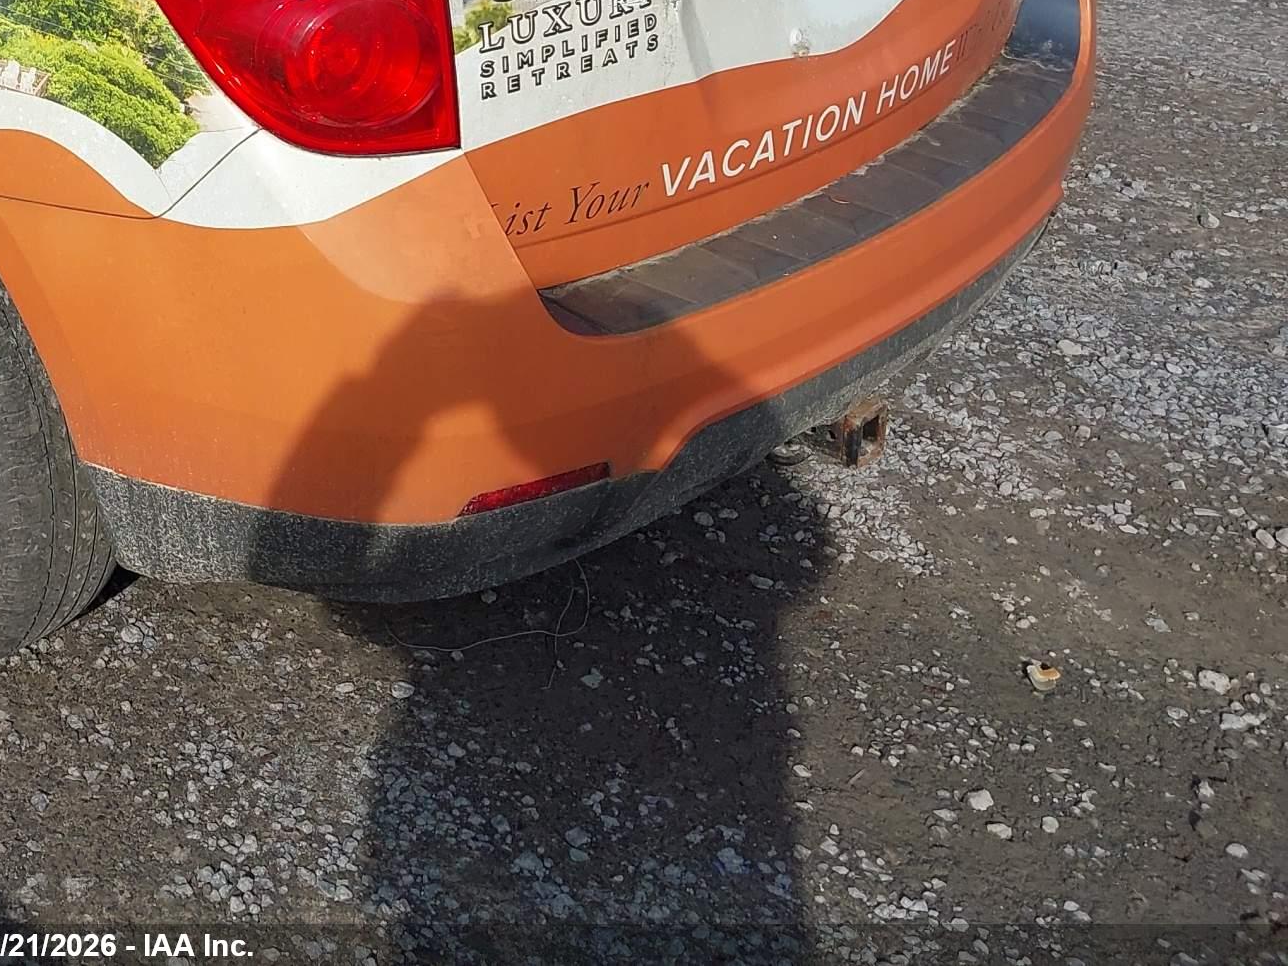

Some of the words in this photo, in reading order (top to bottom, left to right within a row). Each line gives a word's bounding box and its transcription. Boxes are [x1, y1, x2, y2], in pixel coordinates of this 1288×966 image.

[480, 13, 658, 79] SIMPLIFIED
[481, 33, 659, 101] RETREATS
[489, 201, 553, 236] ist
[564, 180, 650, 225] Your
[661, 89, 867, 198] VACATION
[875, 38, 957, 115] HOME
